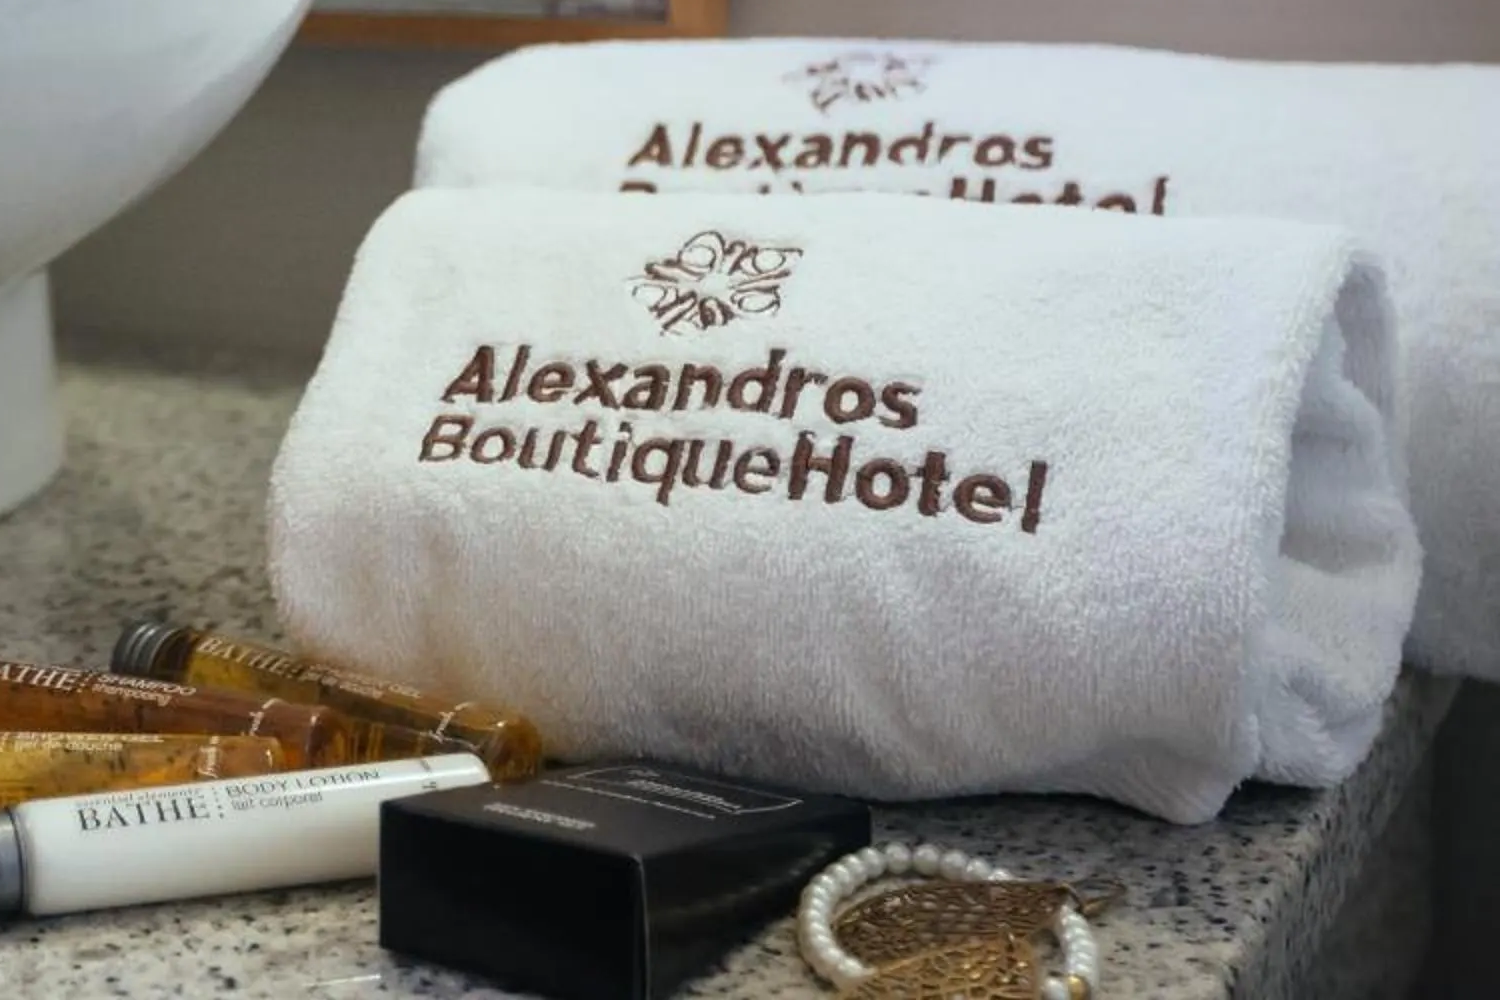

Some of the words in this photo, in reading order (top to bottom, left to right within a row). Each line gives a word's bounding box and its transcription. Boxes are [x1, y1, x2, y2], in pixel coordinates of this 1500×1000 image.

[627, 121, 1054, 171] Alexandros
[440, 344, 923, 429] Alexandros
[225, 780, 287, 797] BODY
[296, 769, 381, 788] LOTION
[78, 798, 210, 830] BATHE
